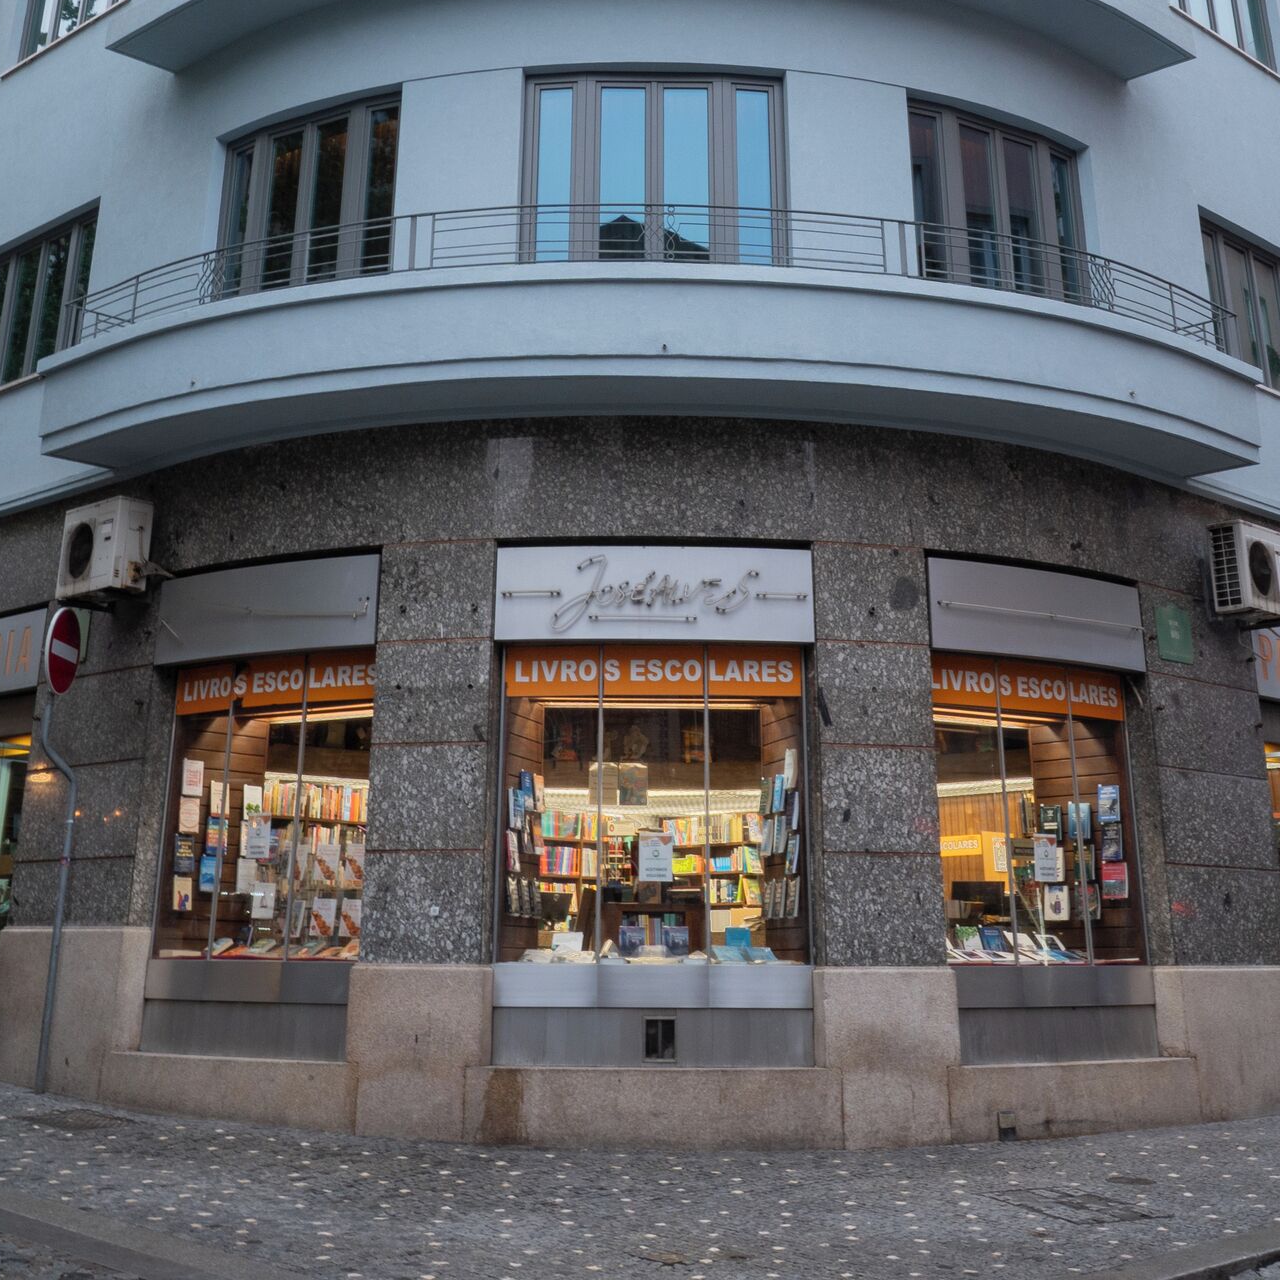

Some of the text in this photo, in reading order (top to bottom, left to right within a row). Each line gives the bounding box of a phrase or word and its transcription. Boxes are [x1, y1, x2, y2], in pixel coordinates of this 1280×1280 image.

[184, 664, 376, 702] LIVROS ESCOLARES
[515, 658, 794, 683] LIVROS ESCOLARES
[931, 669, 1119, 708] LIVROS ESCOLARES
[940, 839, 979, 851] COLARES
